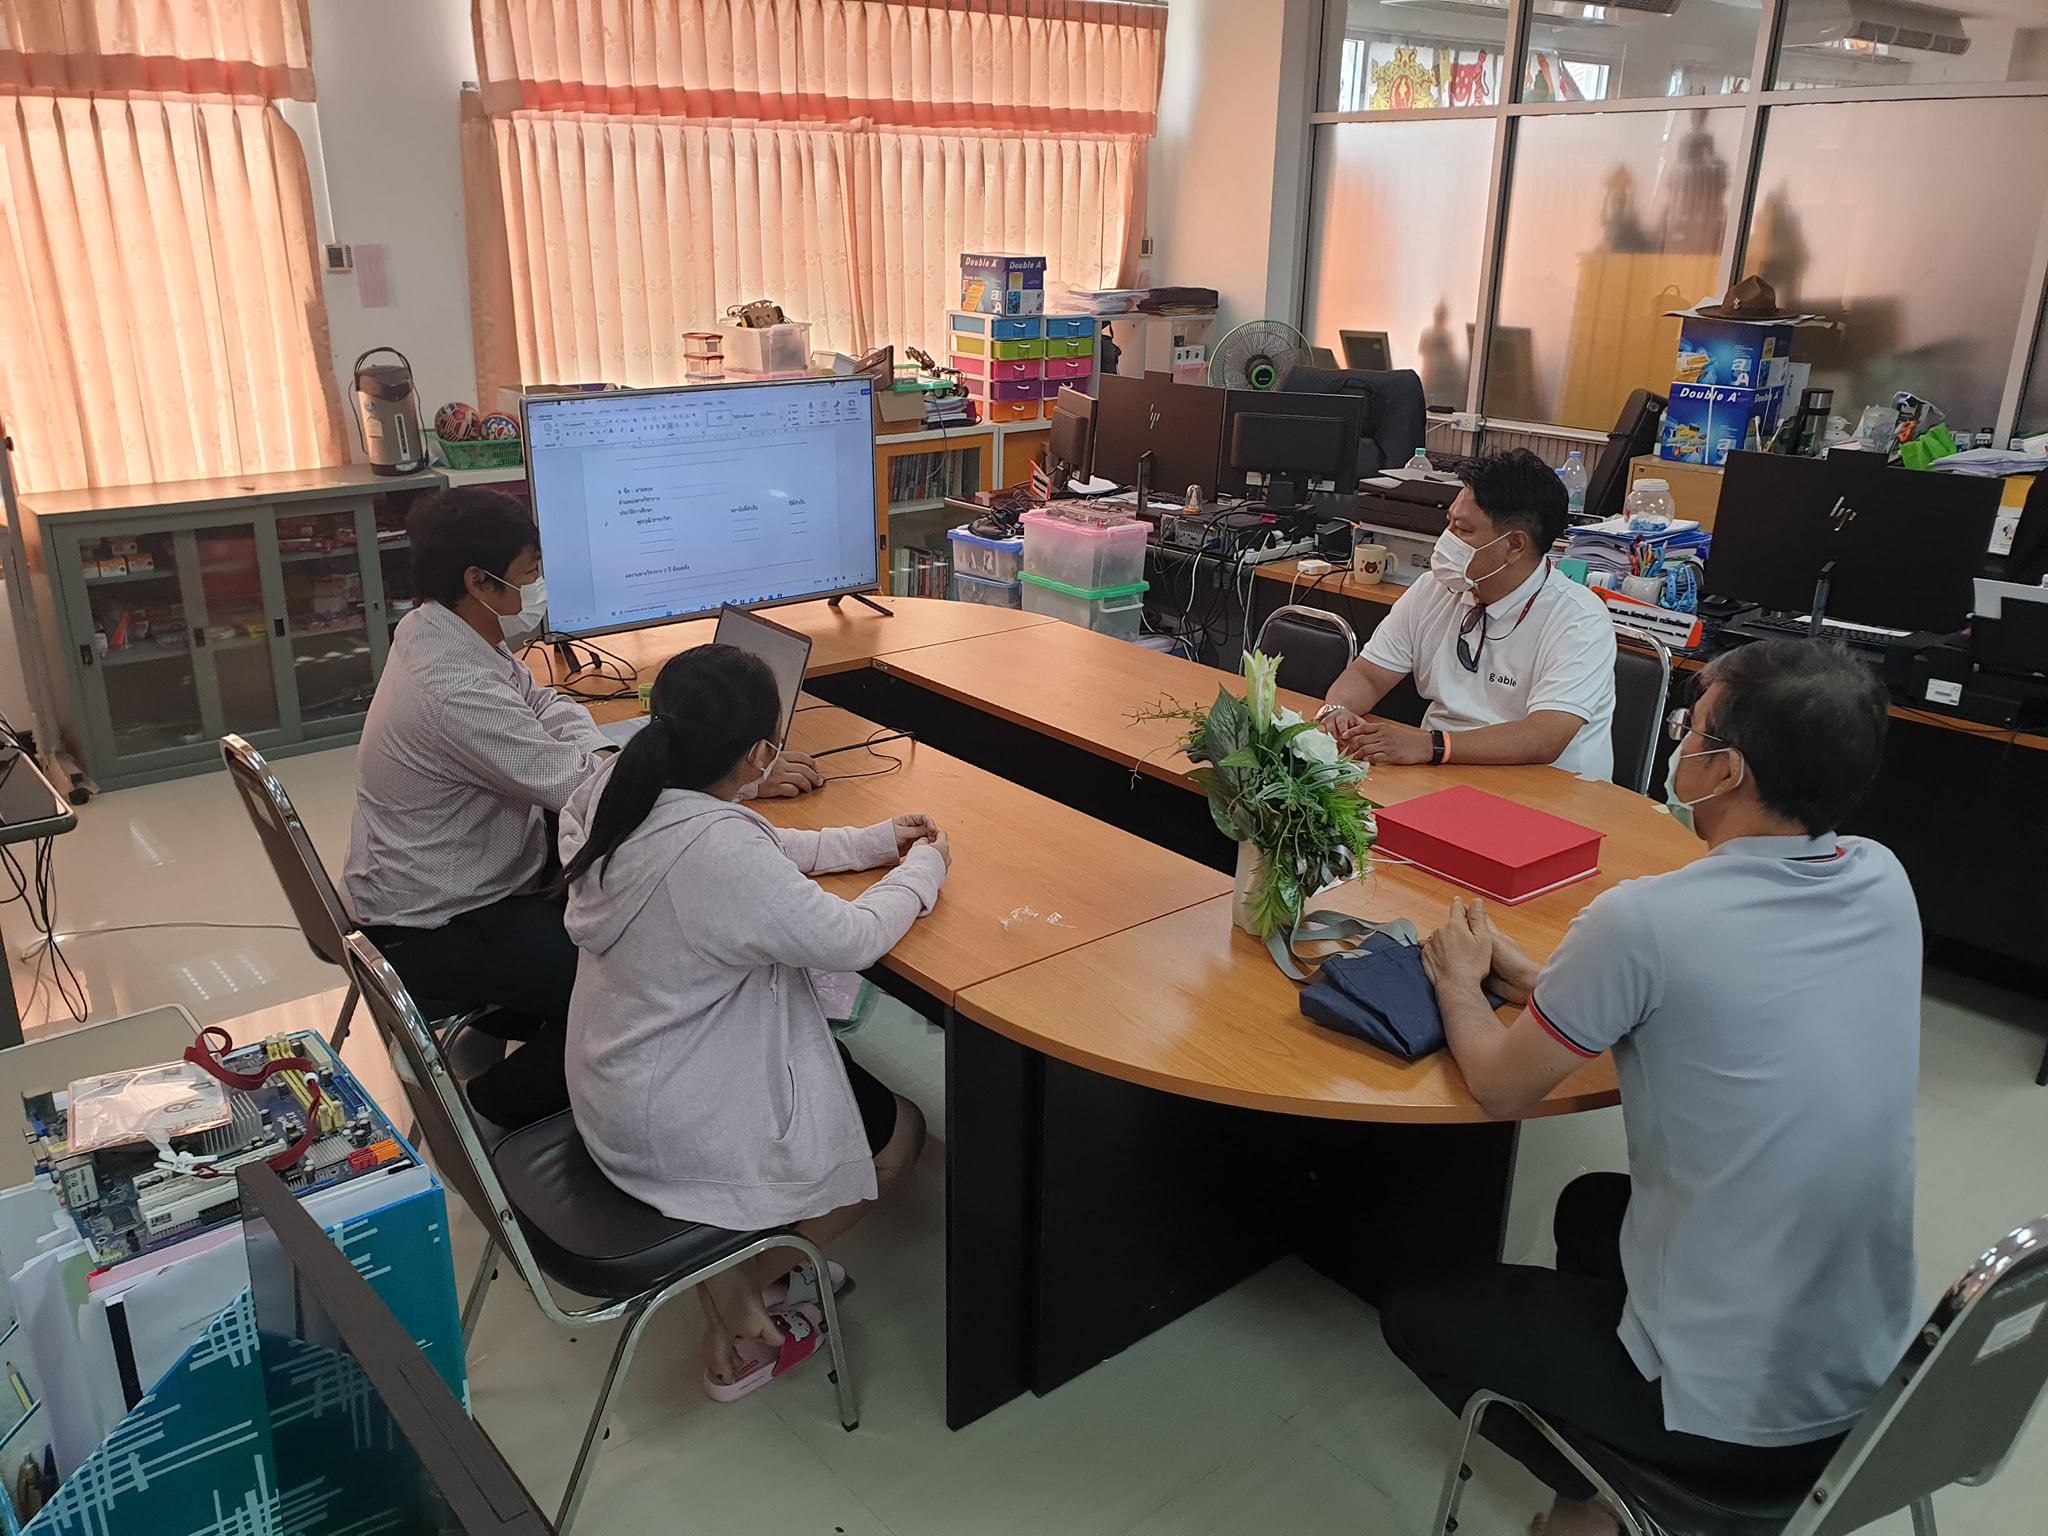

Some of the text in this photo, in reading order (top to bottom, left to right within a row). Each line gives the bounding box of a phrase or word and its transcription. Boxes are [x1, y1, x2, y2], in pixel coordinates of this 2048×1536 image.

[965, 257, 997, 268] Double A
[1009, 261, 1042, 269] Double A
[1680, 387, 1737, 403] Double A
